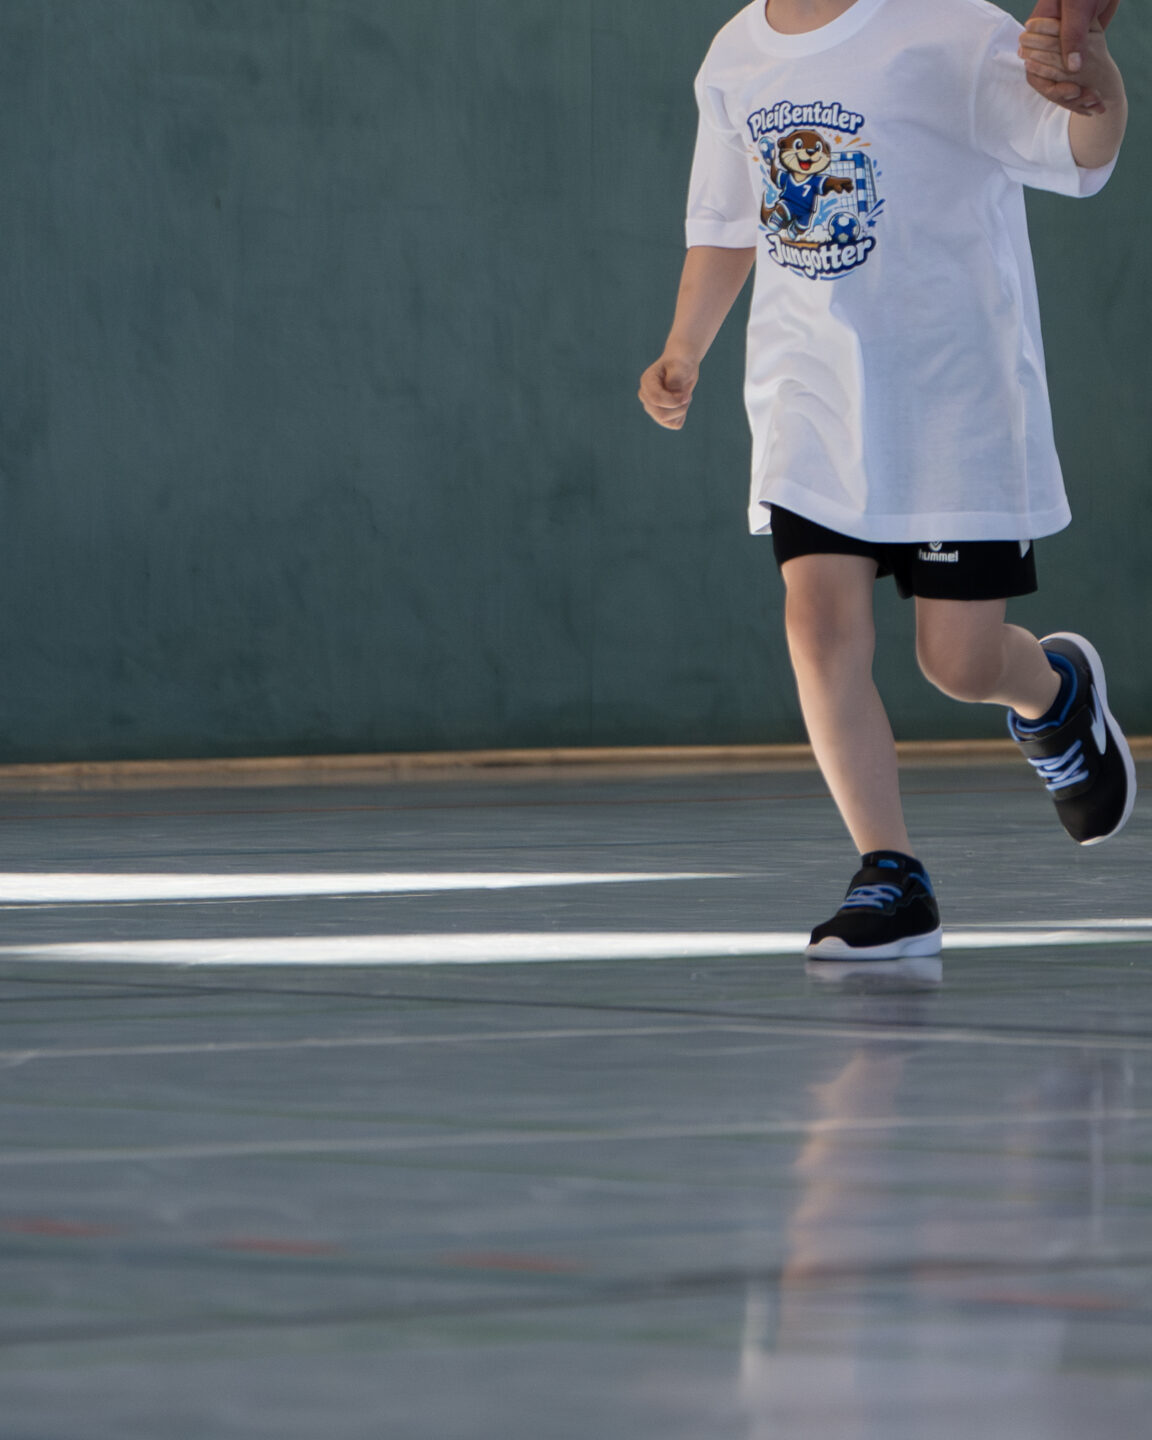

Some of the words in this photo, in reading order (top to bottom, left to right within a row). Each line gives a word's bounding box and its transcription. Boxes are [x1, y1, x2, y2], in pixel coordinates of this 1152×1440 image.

[749, 102, 862, 140] Pleißentaler
[802, 184, 811, 197] 7
[767, 233, 875, 278] Jungotter
[918, 548, 959, 563] hummel
